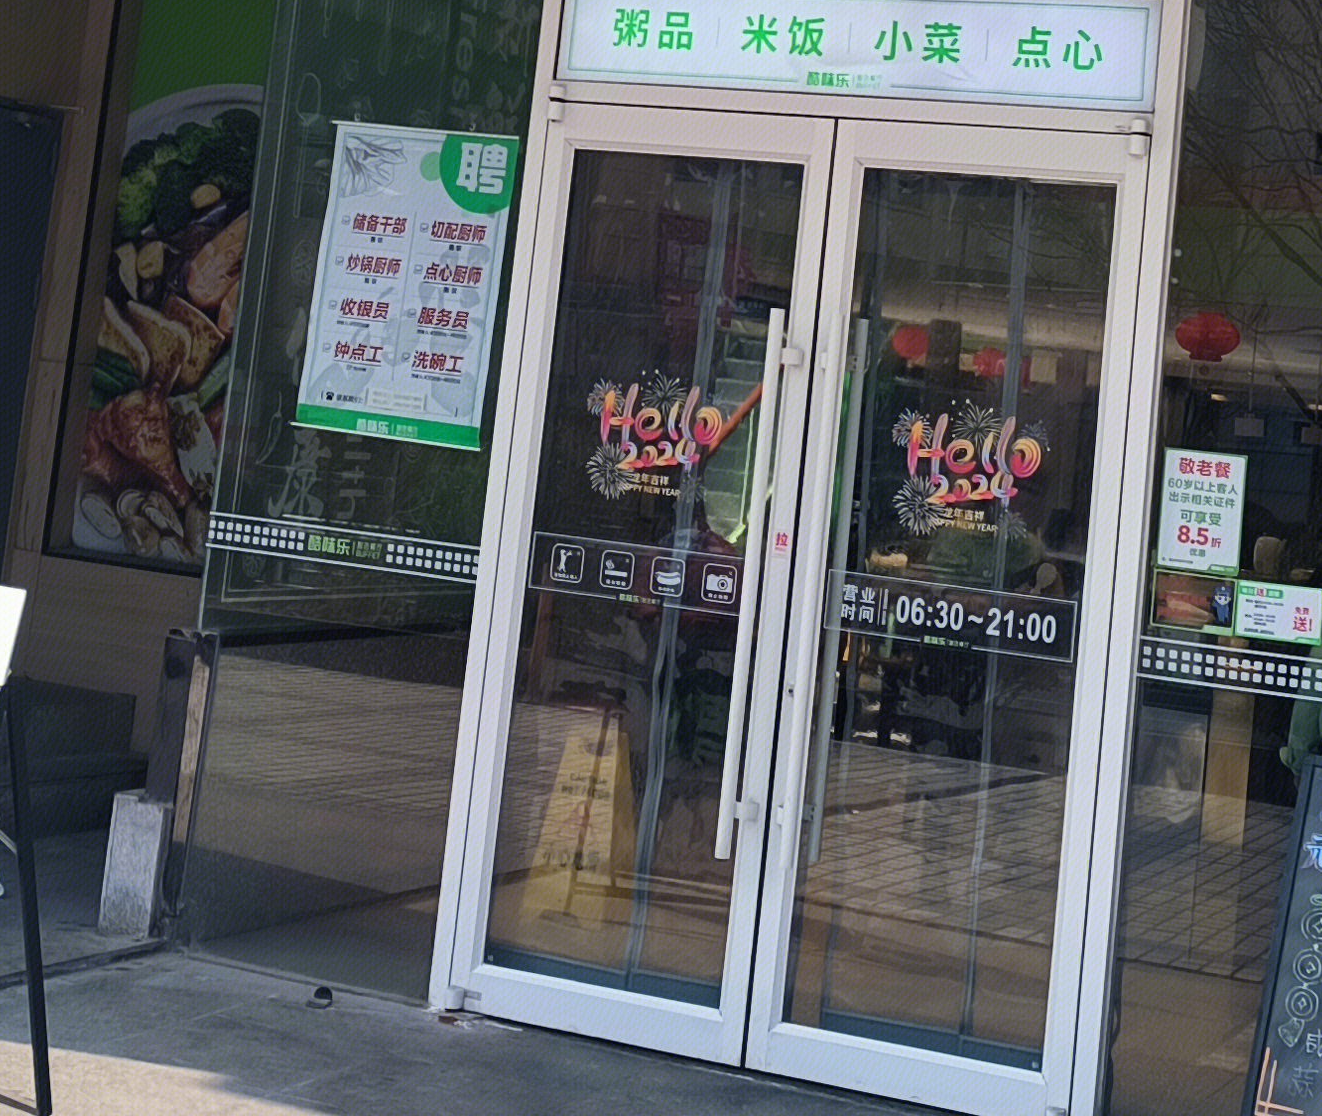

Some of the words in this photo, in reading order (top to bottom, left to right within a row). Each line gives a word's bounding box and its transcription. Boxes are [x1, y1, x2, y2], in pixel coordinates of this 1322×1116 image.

[613, 8, 693, 51] 粥品
[742, 13, 826, 57] 米饭
[874, 20, 963, 65] 小菜
[1012, 25, 1104, 71] 点心
[456, 142, 509, 195] 聘
[352, 212, 408, 235] 储备干部
[430, 220, 488, 243] 切配厨师
[346, 253, 403, 277] 炒锅厨师
[423, 261, 484, 285] 点心厨师
[339, 297, 390, 320] 收银员
[417, 306, 470, 330] 服务员
[333, 340, 384, 364] 钟点工
[411, 349, 465, 374] 洗碗工
[599, 382, 723, 447] Hello
[616, 437, 701, 473] 2024
[907, 412, 1042, 480] Hello
[1178, 457, 1232, 479] 敬老餐
[926, 470, 1019, 508] 2024
[1168, 477, 1238, 496] 60岁以上客人
[1168, 491, 1236, 510] 出示相关证件
[1180, 509, 1222, 527] 可享受
[775, 531, 788, 547] 拉
[843, 583, 877, 605] 营业
[840, 603, 876, 625] 时间
[895, 595, 1057, 644] 06:30~21:00
